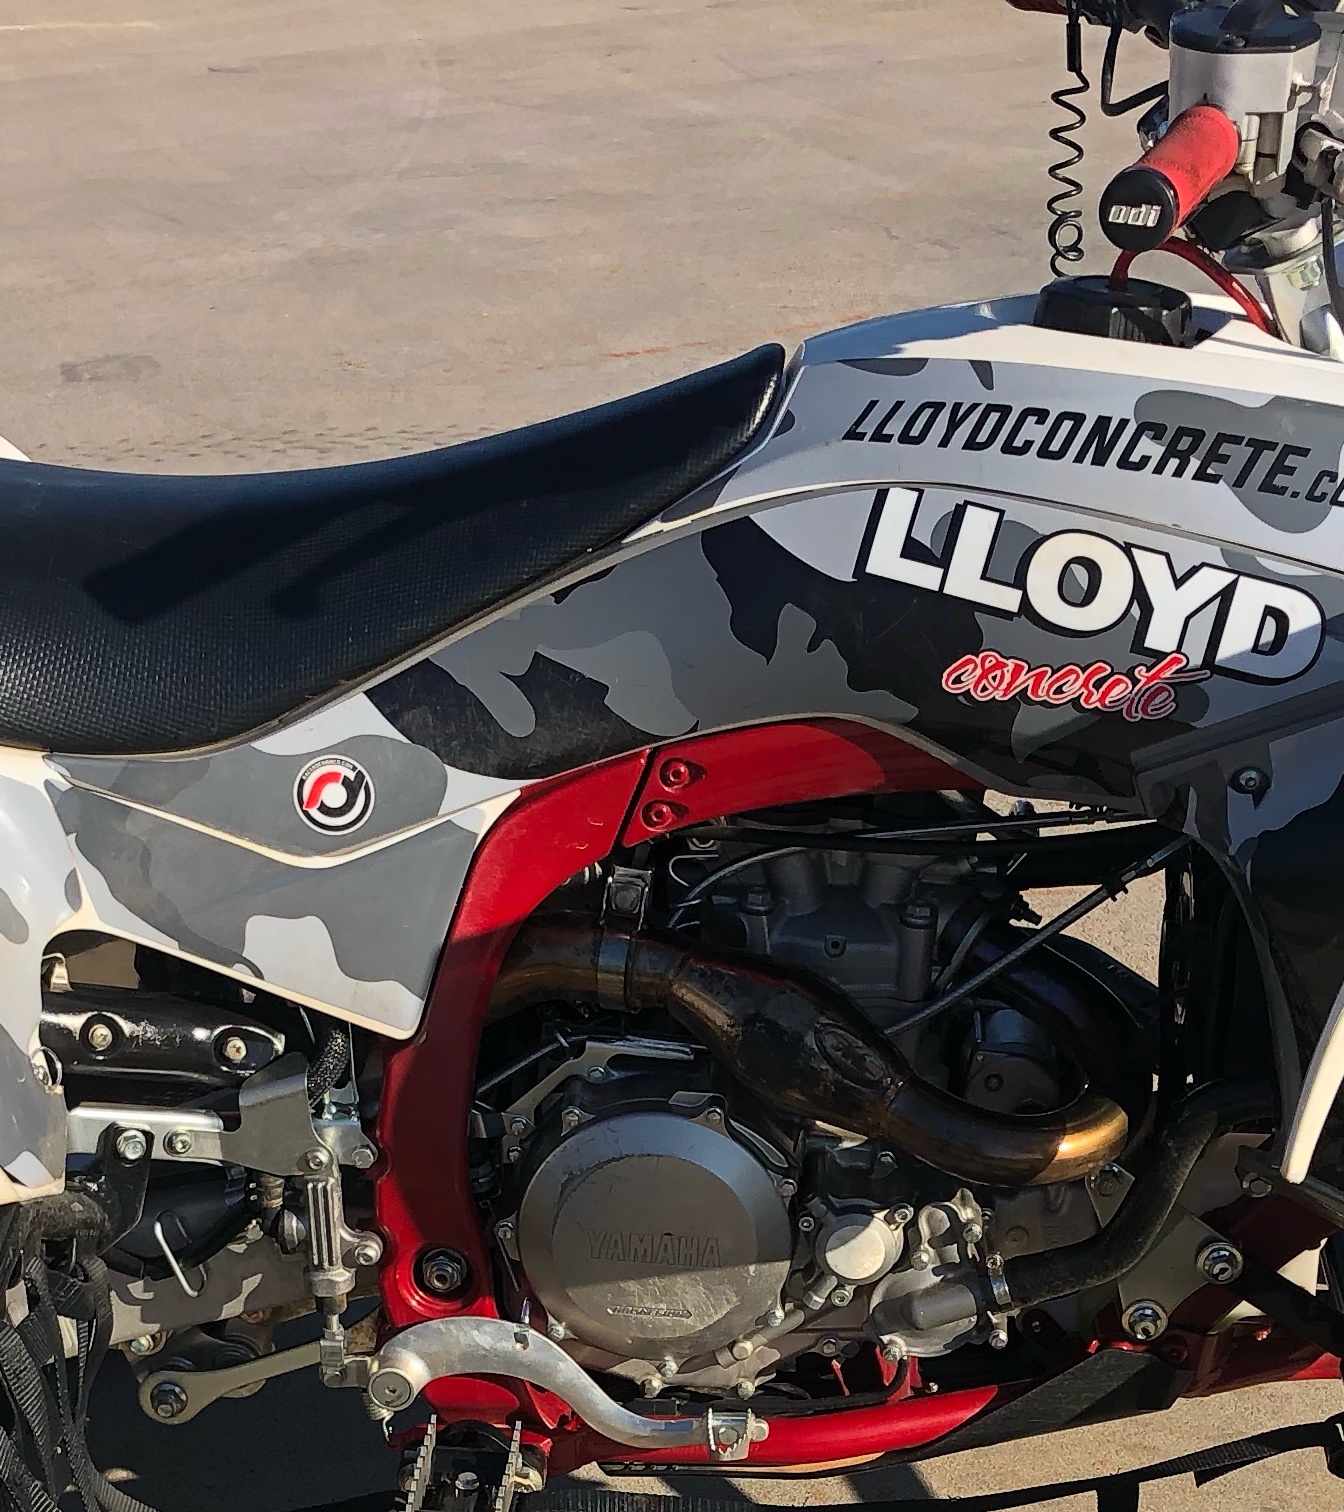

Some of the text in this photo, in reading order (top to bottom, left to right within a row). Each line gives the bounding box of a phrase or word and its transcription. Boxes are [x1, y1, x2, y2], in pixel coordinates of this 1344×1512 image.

[1108, 203, 1162, 228] odi
[859, 487, 1325, 684] LLOYD
[942, 648, 1212, 722] concrete
[586, 1228, 721, 1268] YAMAHA
